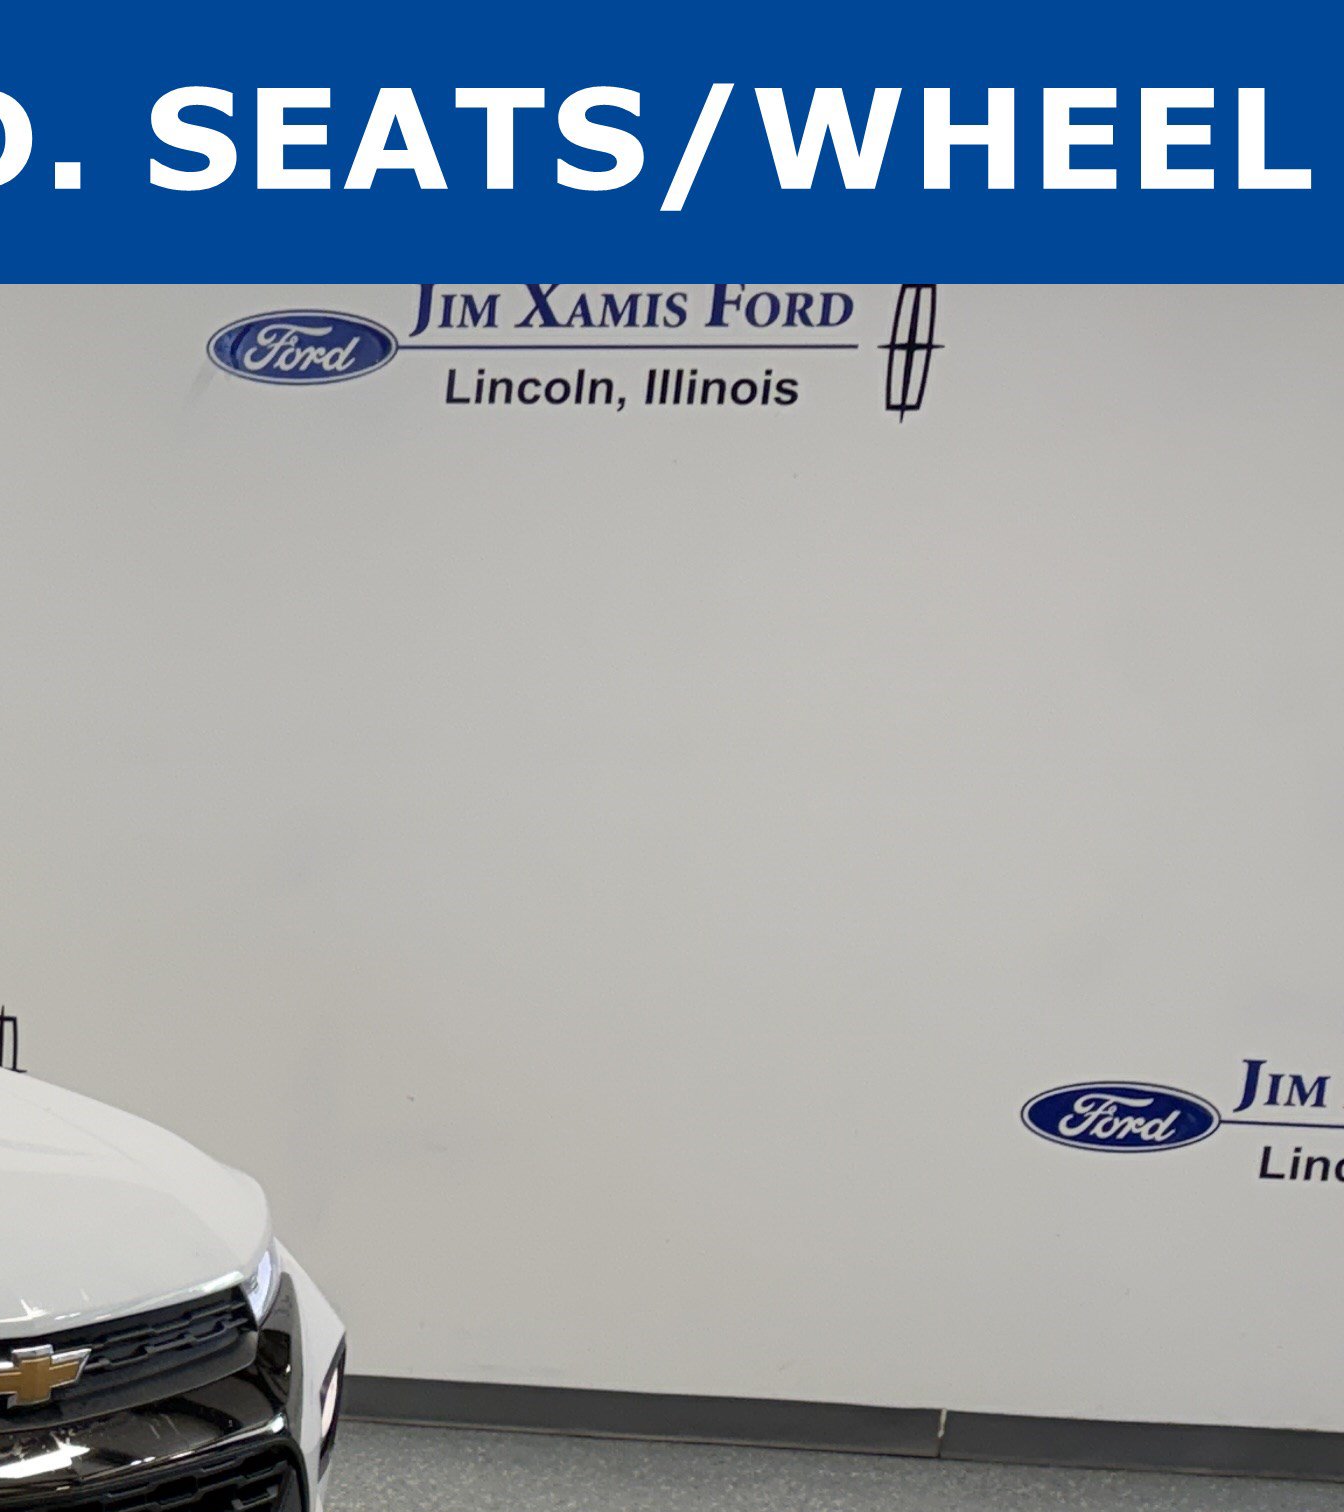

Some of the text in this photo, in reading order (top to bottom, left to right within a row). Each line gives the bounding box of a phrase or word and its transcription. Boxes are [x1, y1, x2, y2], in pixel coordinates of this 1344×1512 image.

[409, 284, 855, 338] JIM XAMIS FORD
[243, 323, 357, 372] Ford
[444, 368, 801, 412] Lincoln, Illinois
[1232, 1058, 1331, 1114] JIM
[1058, 1093, 1182, 1142] Ford
